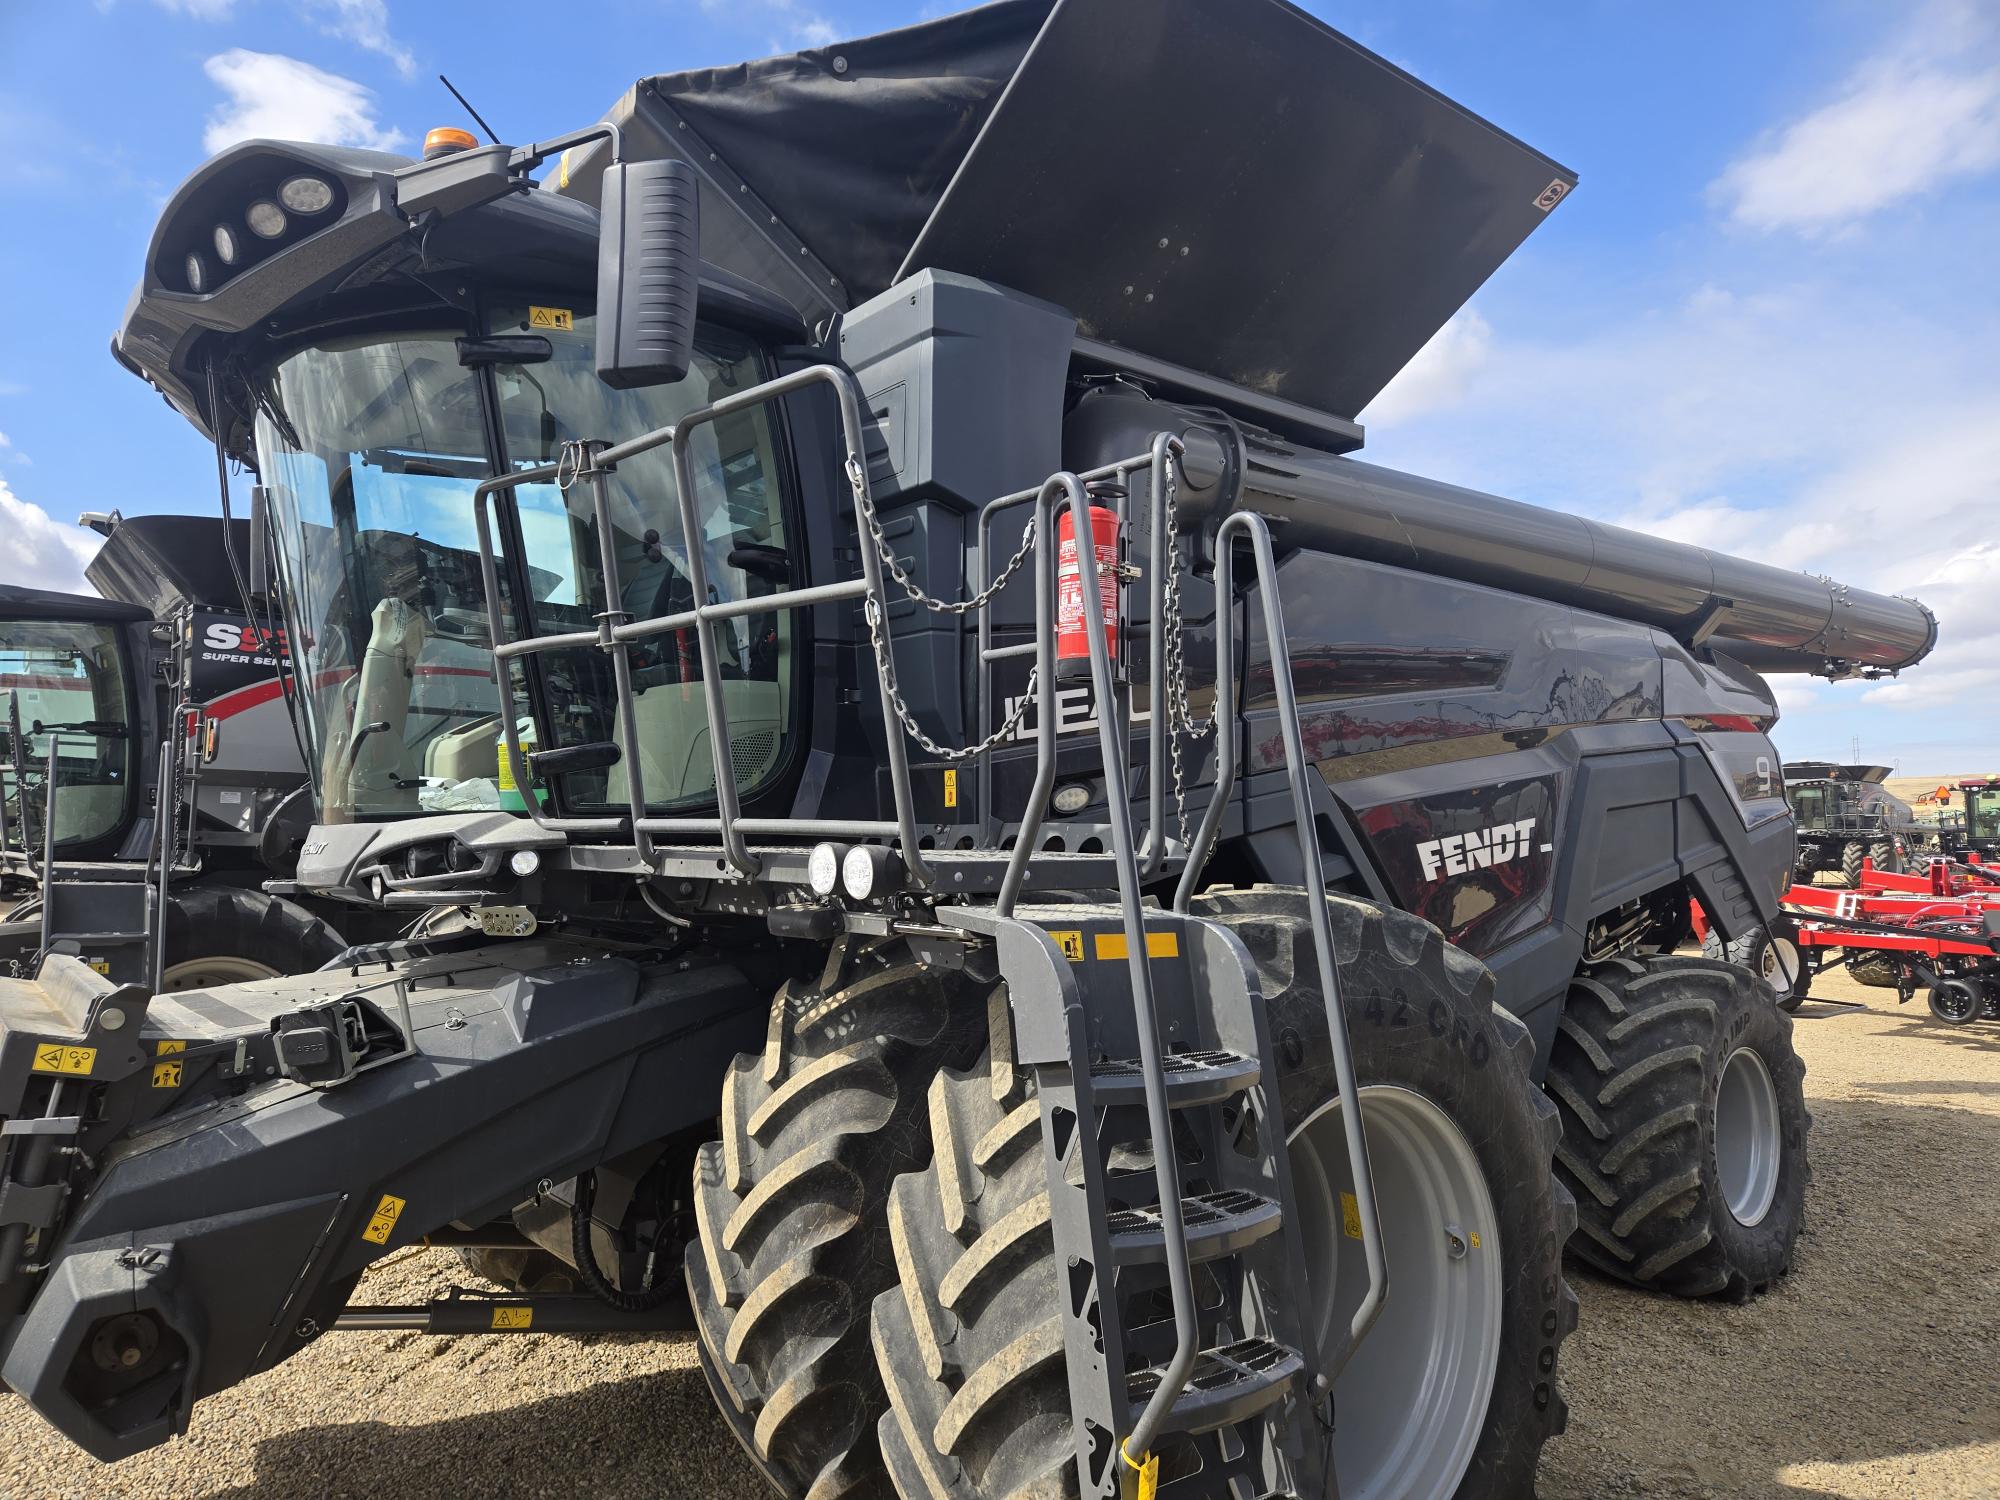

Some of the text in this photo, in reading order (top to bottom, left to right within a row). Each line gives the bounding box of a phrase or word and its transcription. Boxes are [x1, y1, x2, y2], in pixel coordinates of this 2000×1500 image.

[202, 652, 250, 664] SUPER
[1756, 756, 1771, 792] 9
[1415, 817, 1537, 882] FENDT
